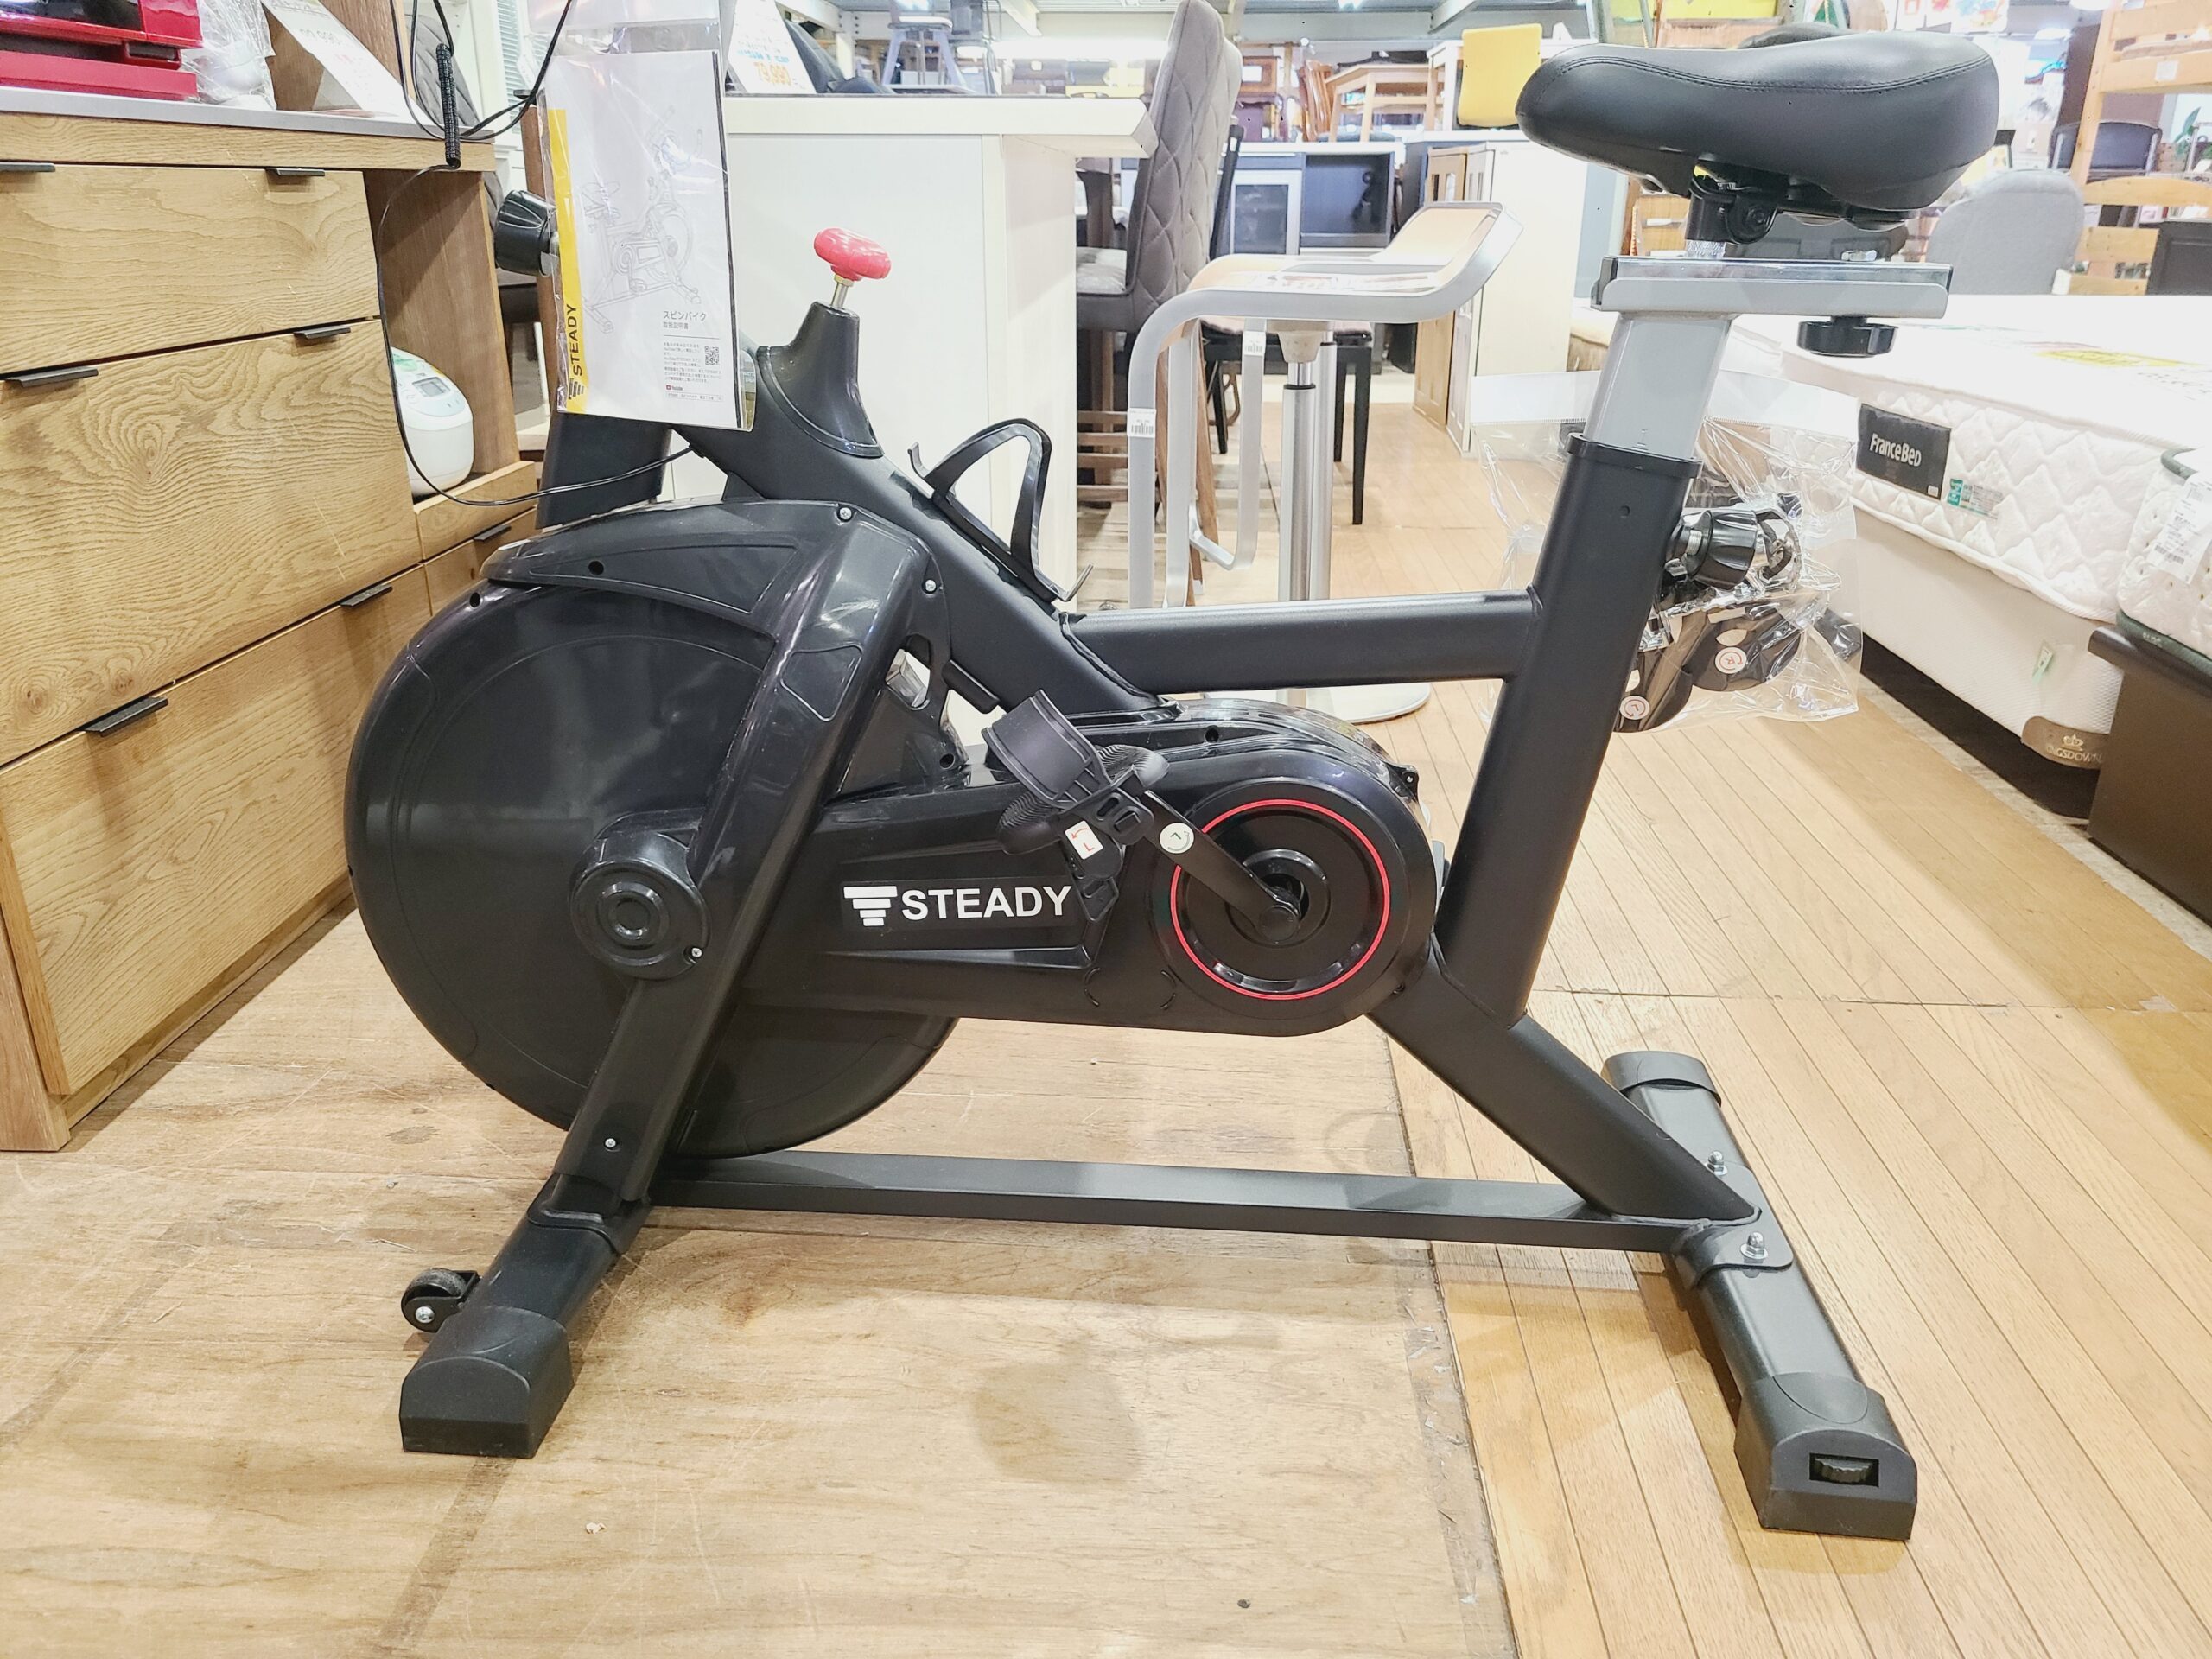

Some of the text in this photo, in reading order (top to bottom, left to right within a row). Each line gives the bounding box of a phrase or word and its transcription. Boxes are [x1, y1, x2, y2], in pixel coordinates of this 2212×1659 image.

[663, 310, 707, 322] スピンバイク
[566, 303, 583, 376] STEADY
[1083, 842, 1095, 852] L
[901, 885, 1072, 921] STEADY
